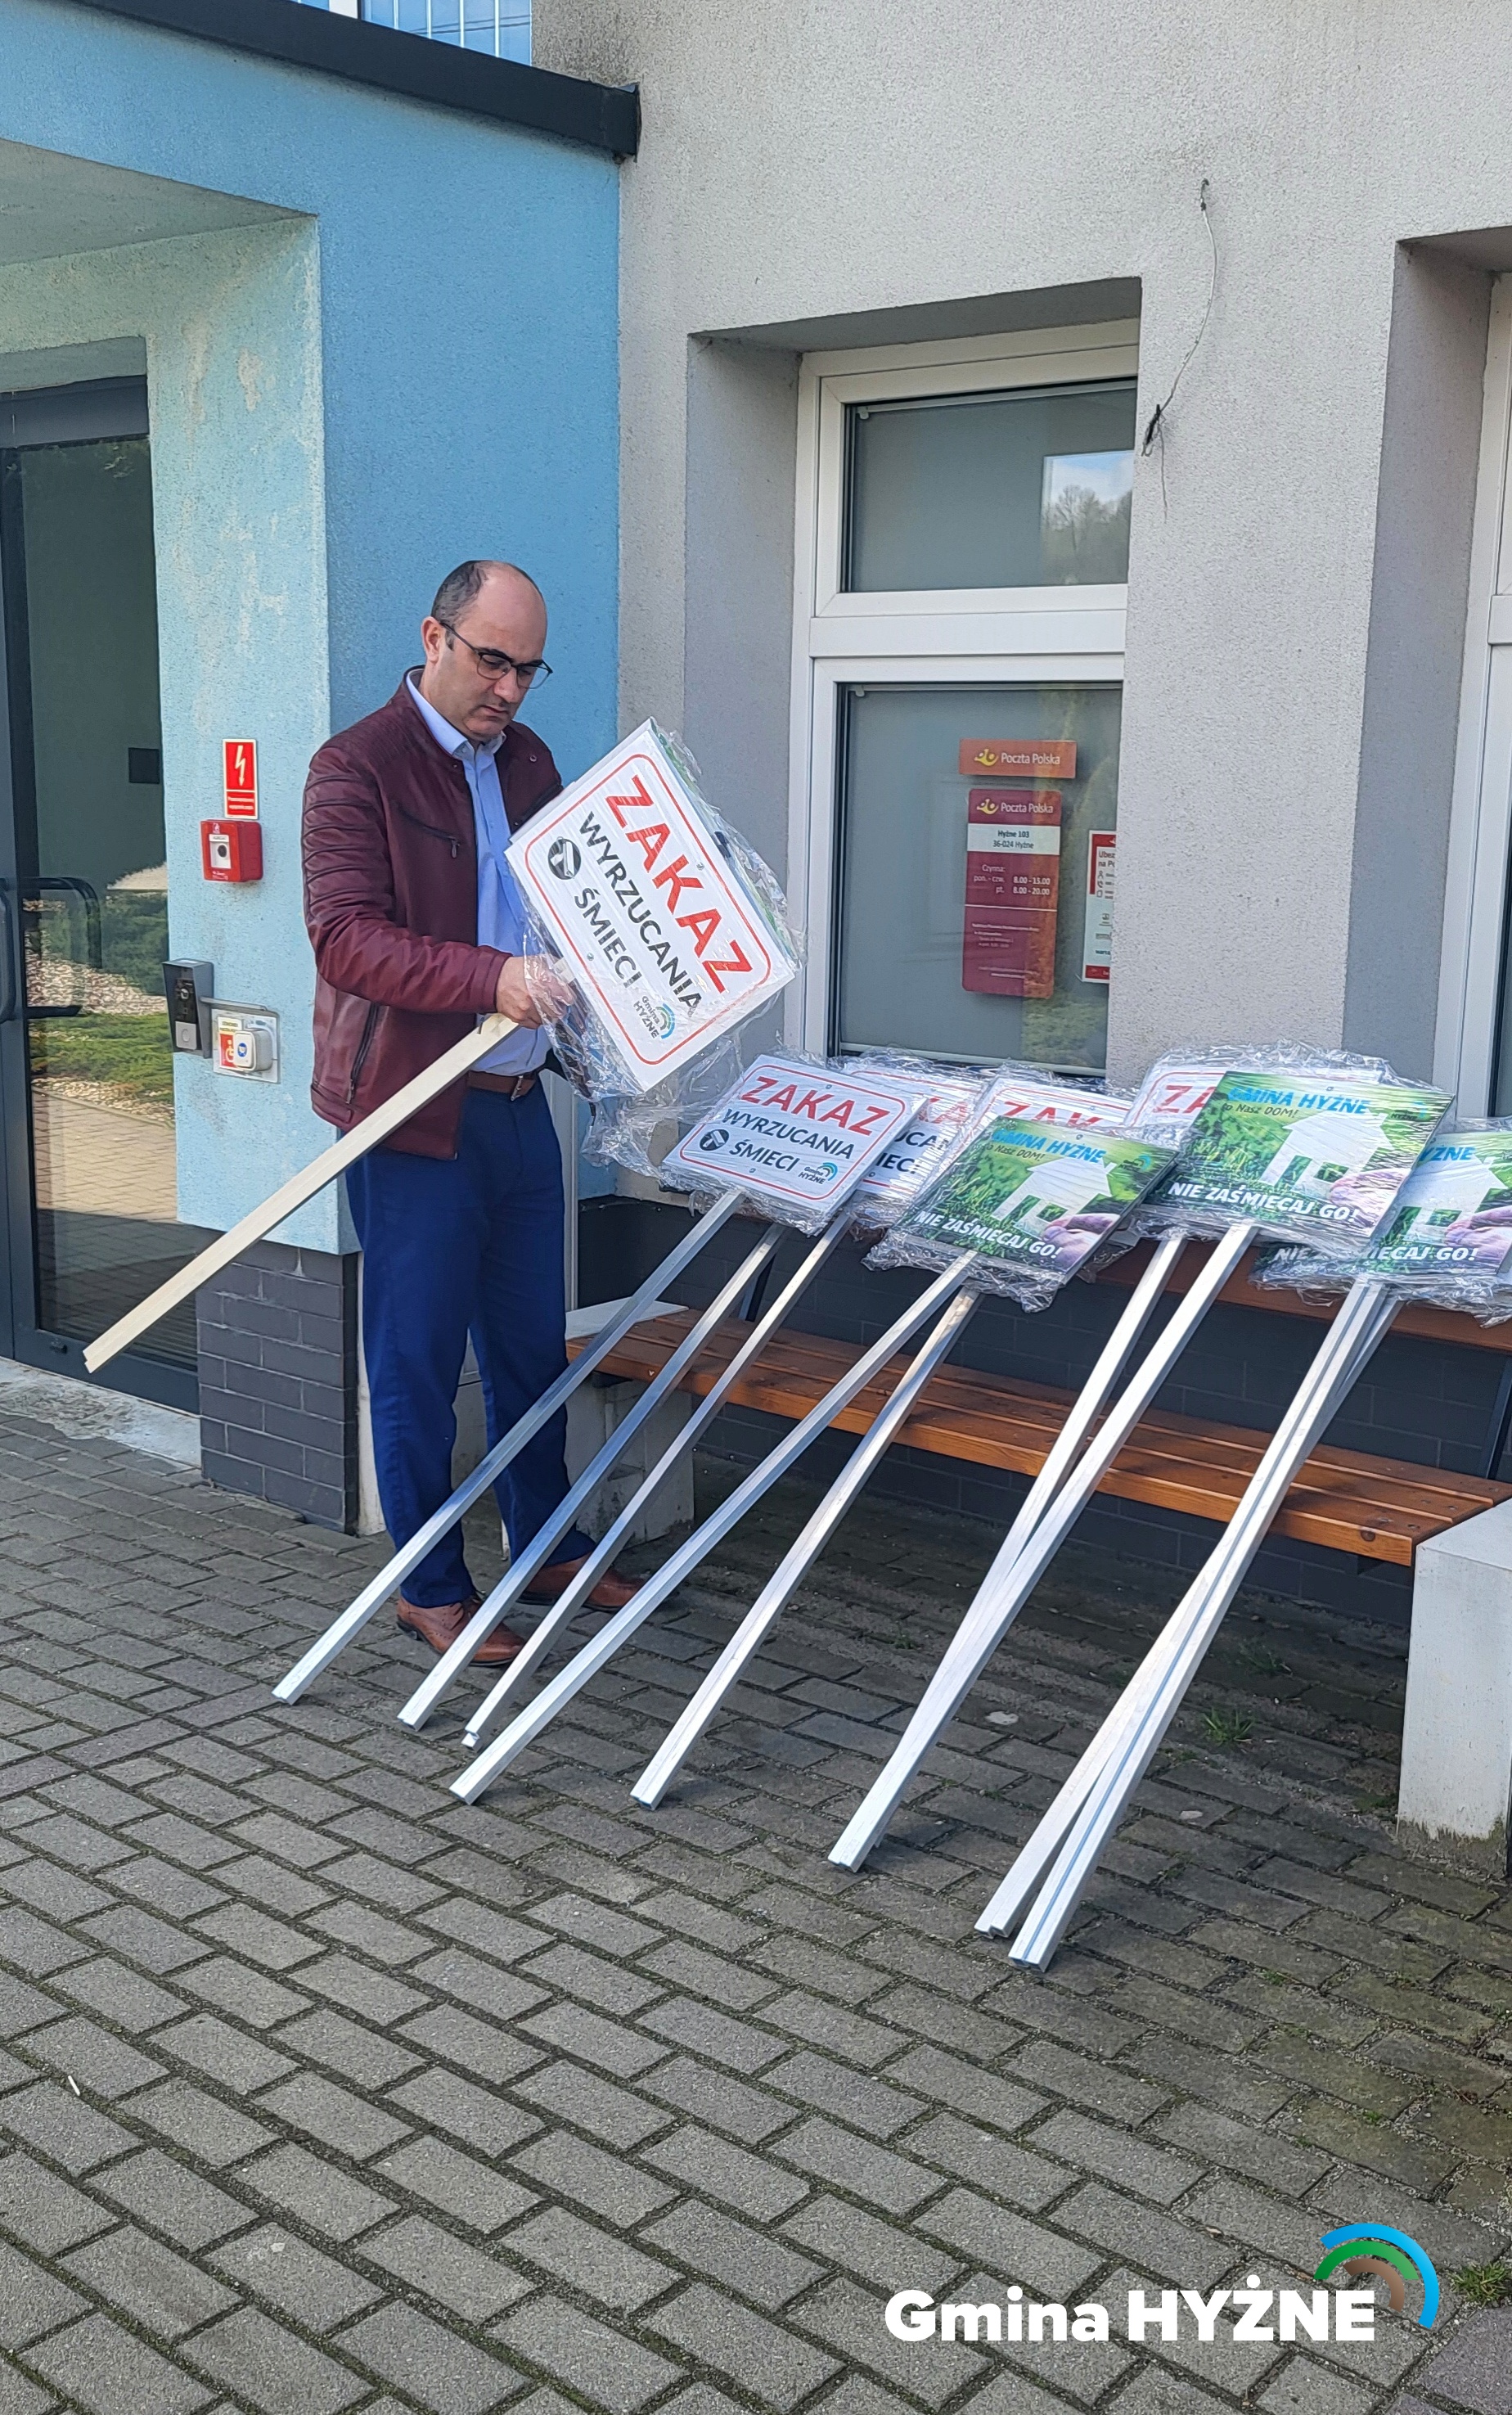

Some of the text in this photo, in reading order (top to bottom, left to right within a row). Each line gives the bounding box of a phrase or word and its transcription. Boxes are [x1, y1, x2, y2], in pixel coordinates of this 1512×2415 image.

[1001, 752, 1061, 765] Poczta Polska
[1001, 802, 1054, 813] Poczta Polska
[992, 840, 1014, 848] 36-024
[998, 830, 1017, 839] Hyżne
[605, 774, 753, 993] ZAKAZ
[1013, 876, 1028, 884] 8.00
[1013, 886, 1027, 894] 8.00
[1032, 887, 1050, 895] 20.00
[578, 811, 703, 1017] WYRZUCANIA
[574, 887, 641, 989] ŚMIECI
[740, 1076, 890, 1136] ZAKAZ
[1228, 1086, 1371, 1115] GMINA HYŻNE
[1235, 1103, 1261, 1114] Nasz
[1263, 1106, 1299, 1119] DOM!
[722, 1109, 855, 1160] WYRZUCANIA
[729, 1139, 800, 1172] ŚMIECI
[1016, 1149, 1046, 1162] DOM!
[1046, 1141, 1107, 1163] HYŻNE
[1168, 1182, 1361, 1222] NIE ZAŚMIECAJ GO!
[913, 1210, 1064, 1259] NIE ZAŚMIECAJ GO!
[1435, 1247, 1479, 1261] GO!
